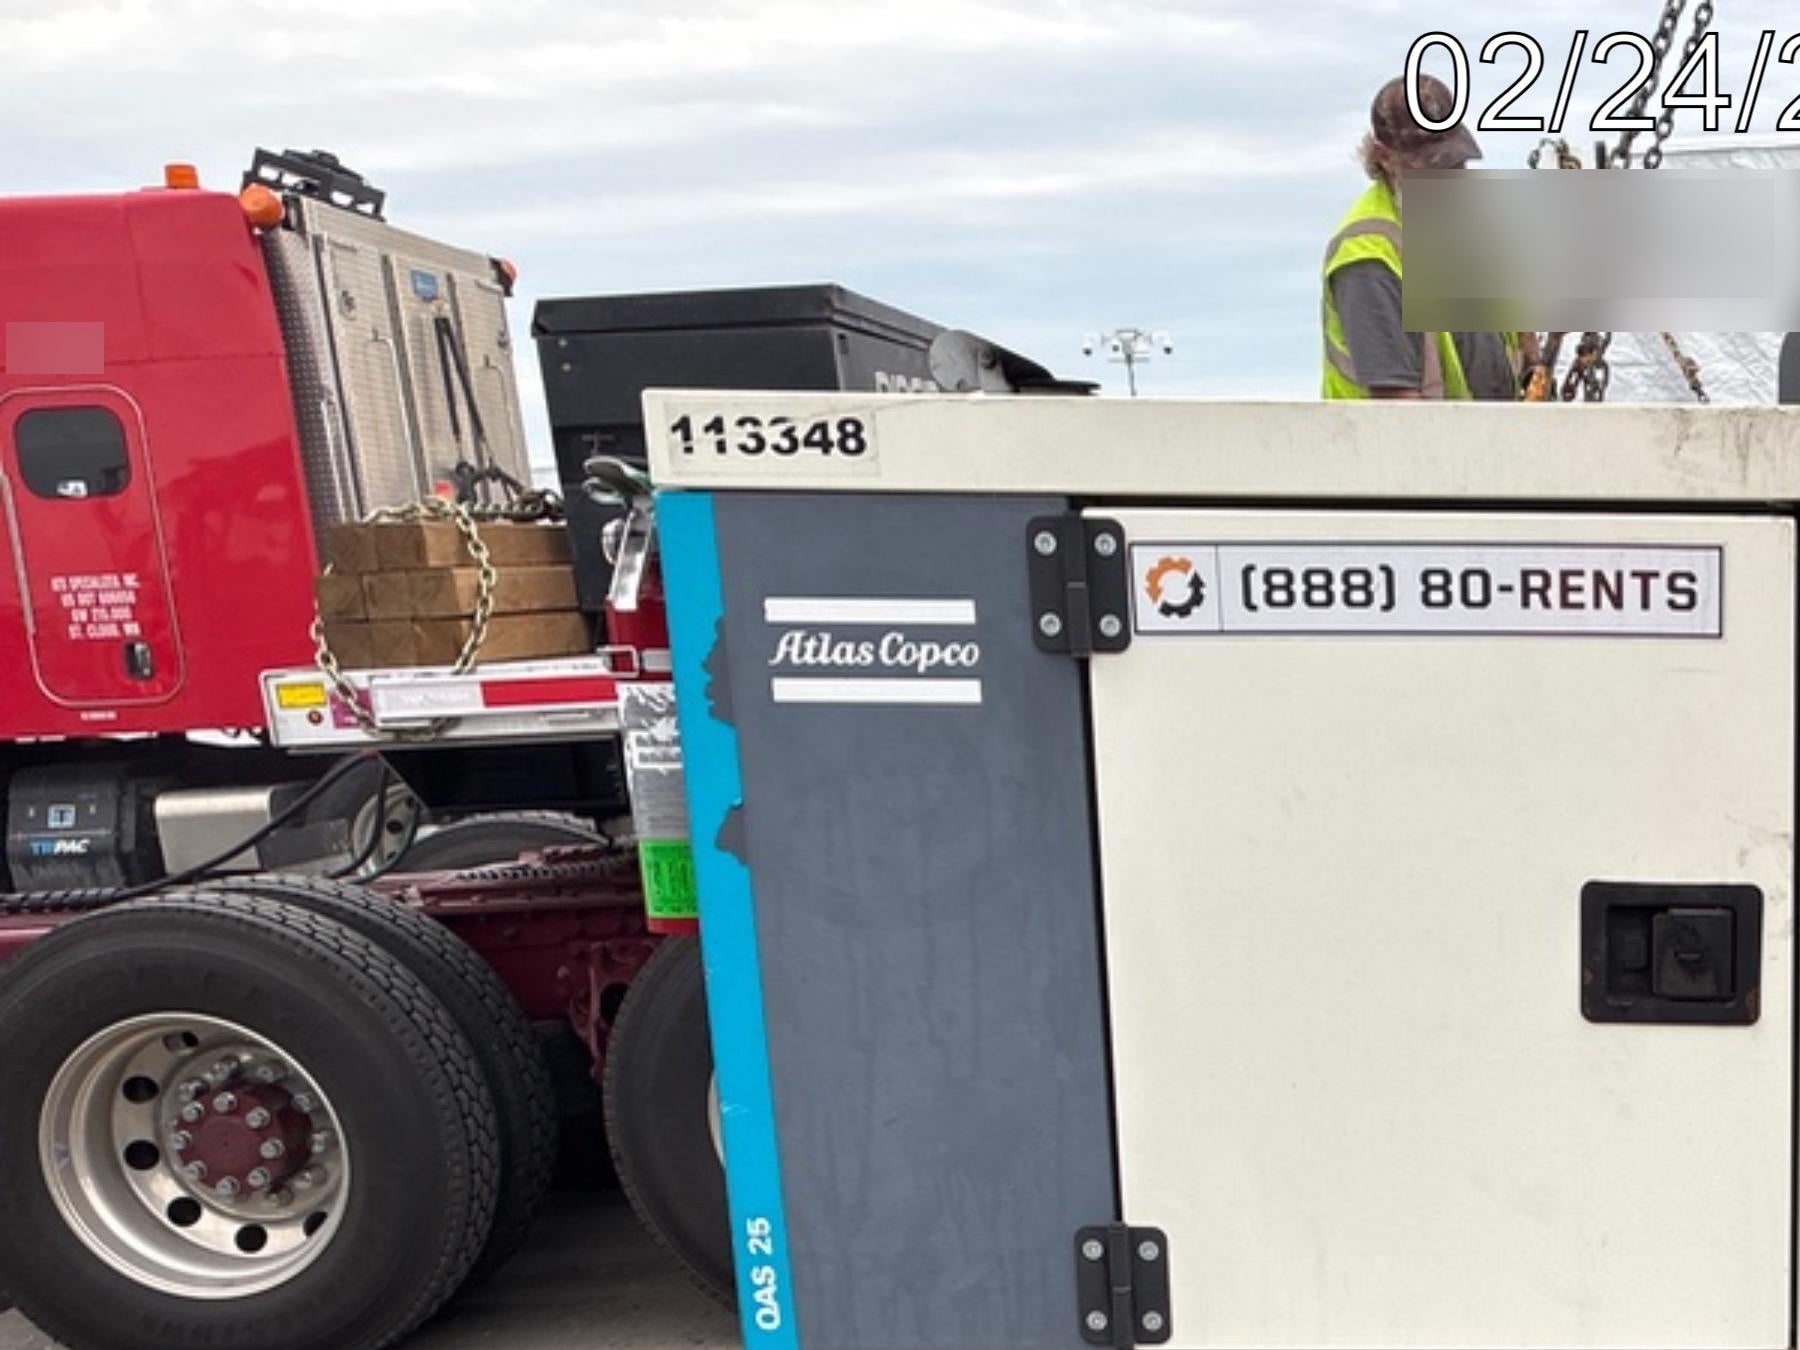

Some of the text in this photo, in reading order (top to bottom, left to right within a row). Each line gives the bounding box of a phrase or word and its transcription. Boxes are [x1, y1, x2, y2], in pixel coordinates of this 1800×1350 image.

[670, 415, 867, 456] 113348
[1240, 563, 1699, 613] (888) 80-RENTS
[768, 630, 980, 674] Atlas Copco
[745, 1217, 772, 1255] 25
